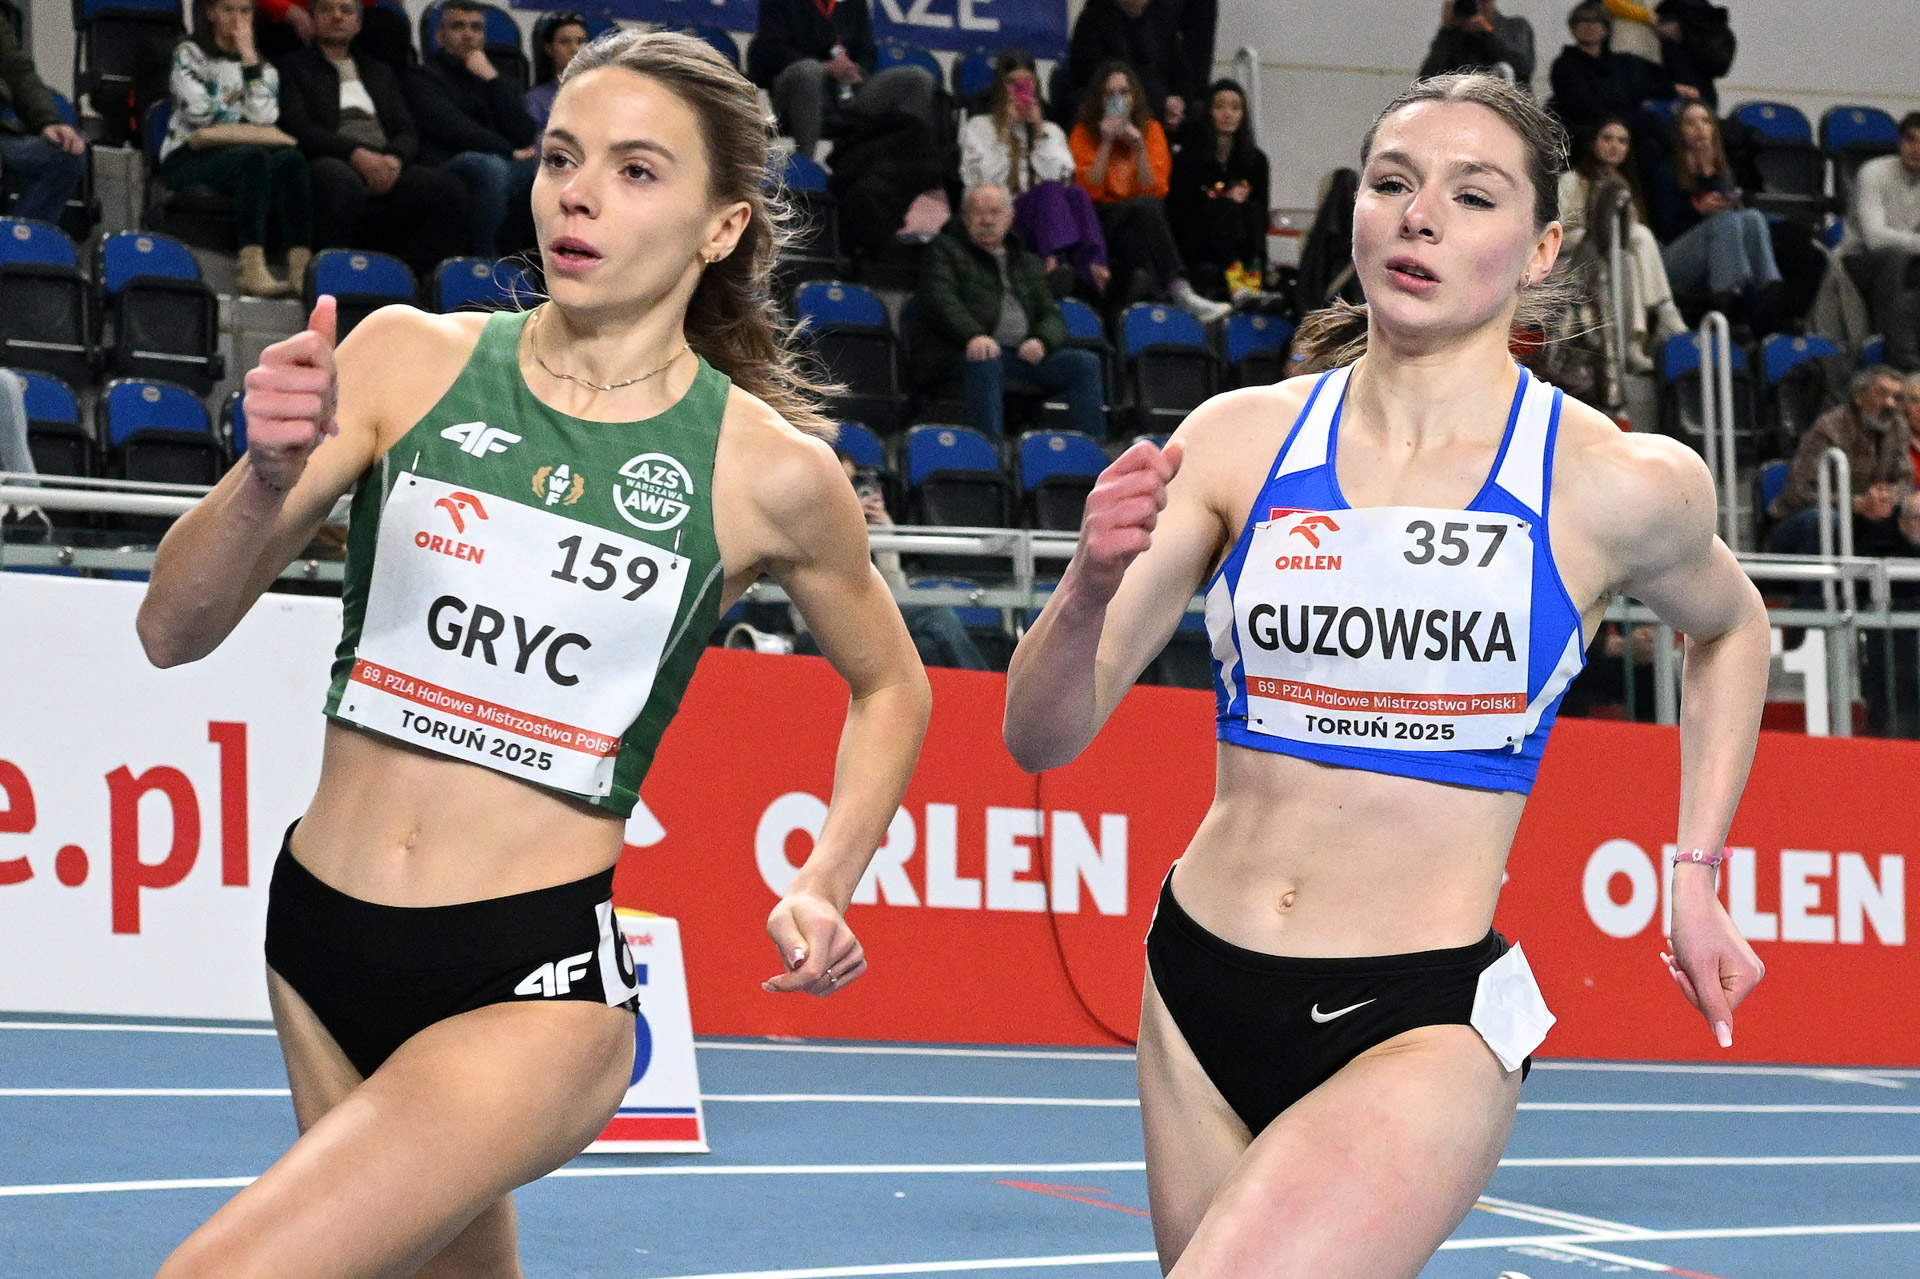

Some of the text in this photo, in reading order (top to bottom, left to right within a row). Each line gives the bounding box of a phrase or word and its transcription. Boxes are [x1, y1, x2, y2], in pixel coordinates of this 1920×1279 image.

[440, 421, 522, 458] 4F
[625, 478, 684, 502] WARSZAWA
[635, 462, 681, 490] AZS
[623, 489, 677, 518] AWF
[414, 531, 485, 564] ORLEN
[1275, 555, 1342, 571] ORLEN
[1403, 520, 1508, 568] 357
[551, 535, 659, 602] 159
[427, 595, 592, 687] GRYC
[1248, 603, 1516, 663] GUZOWSKA
[362, 666, 382, 684] 69.
[384, 674, 414, 695] PZLA
[416, 684, 474, 714] Halowe
[476, 706, 573, 743] Mistrzostwa
[1258, 680, 1516, 711] 69. PZLA Halowe Mistrzostwa Polski
[401, 709, 554, 771] TORUŃ 2025
[1305, 714, 1455, 740] TORUŃ 2025
[754, 791, 1128, 916] ORLEN
[1582, 838, 1906, 947] OLEN
[514, 951, 593, 998] 4F
